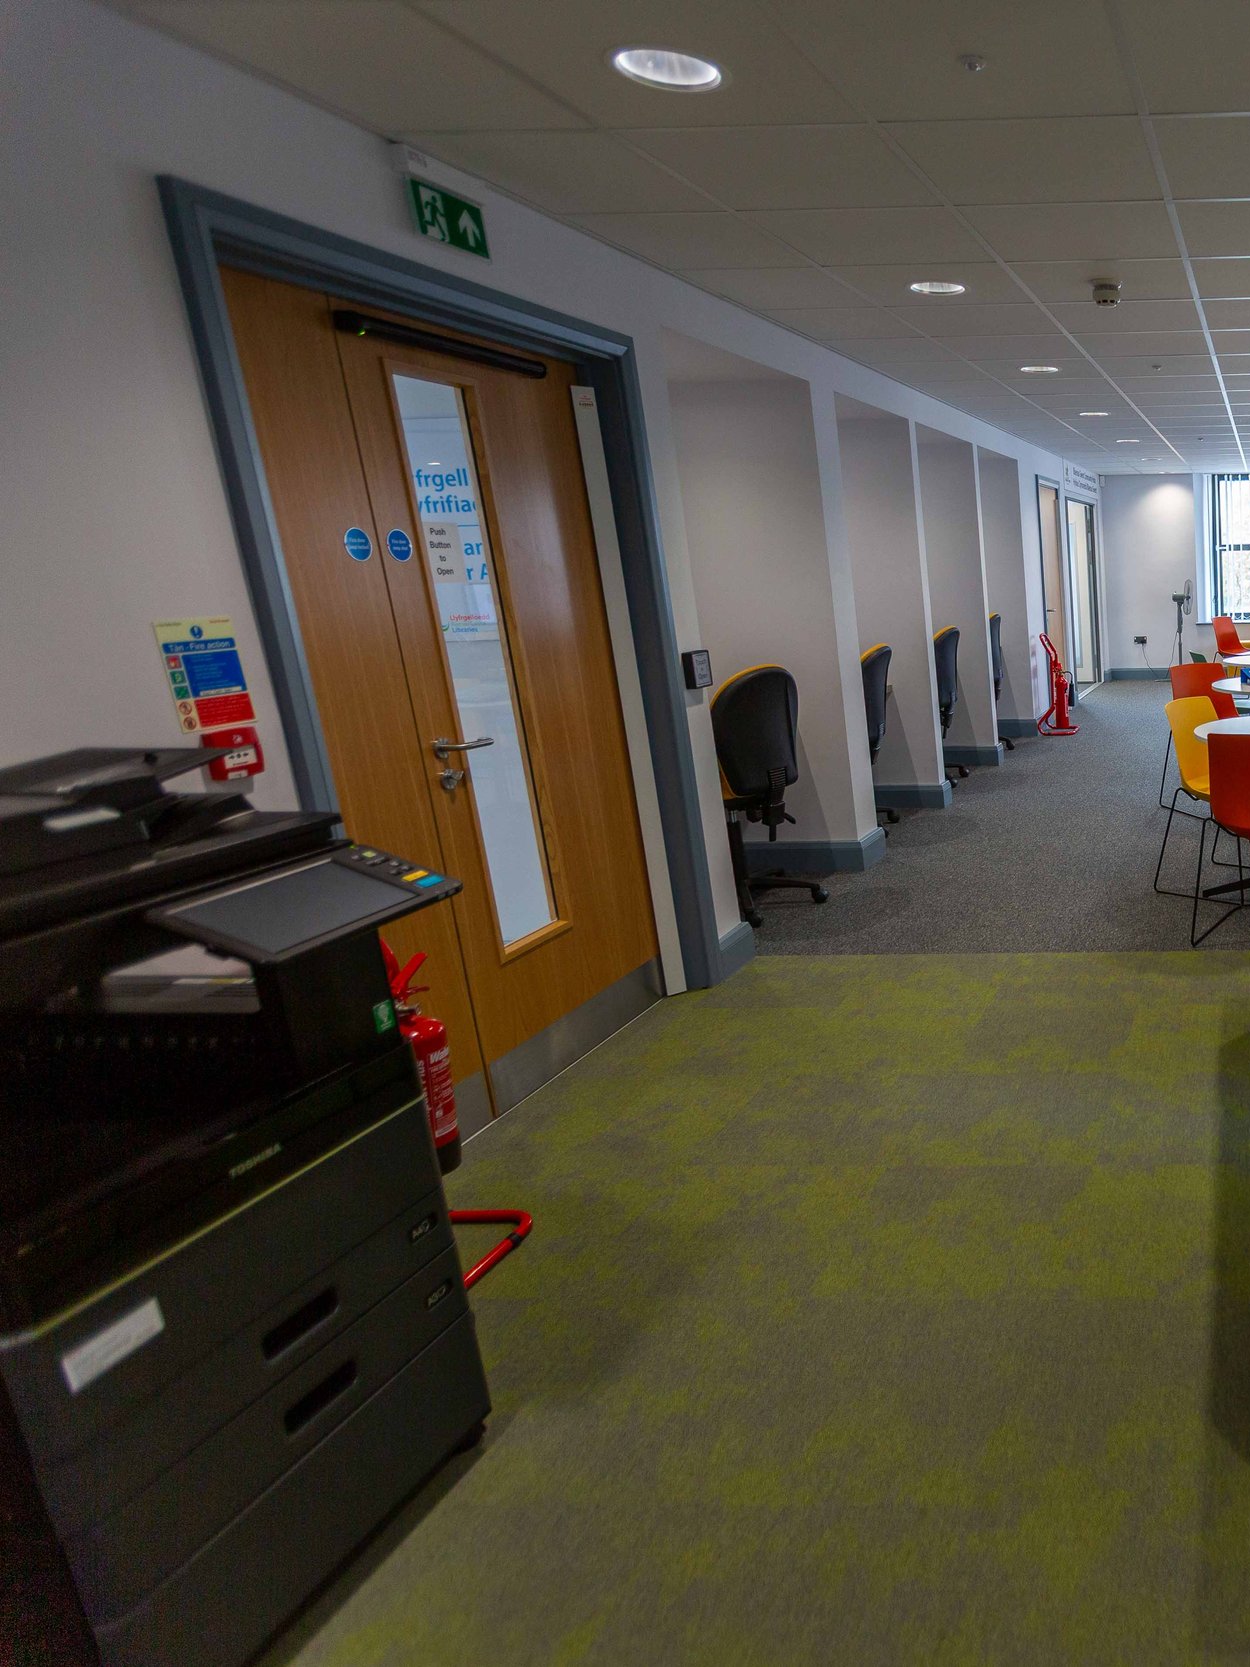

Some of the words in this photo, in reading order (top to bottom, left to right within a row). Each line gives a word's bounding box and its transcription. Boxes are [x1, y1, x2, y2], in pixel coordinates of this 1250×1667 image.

[415, 468, 469, 492] frgell
[429, 527, 446, 536] Push
[429, 541, 451, 549] Button
[436, 567, 454, 576] Open
[189, 642, 205, 651] Fire
[207, 640, 231, 650] action
